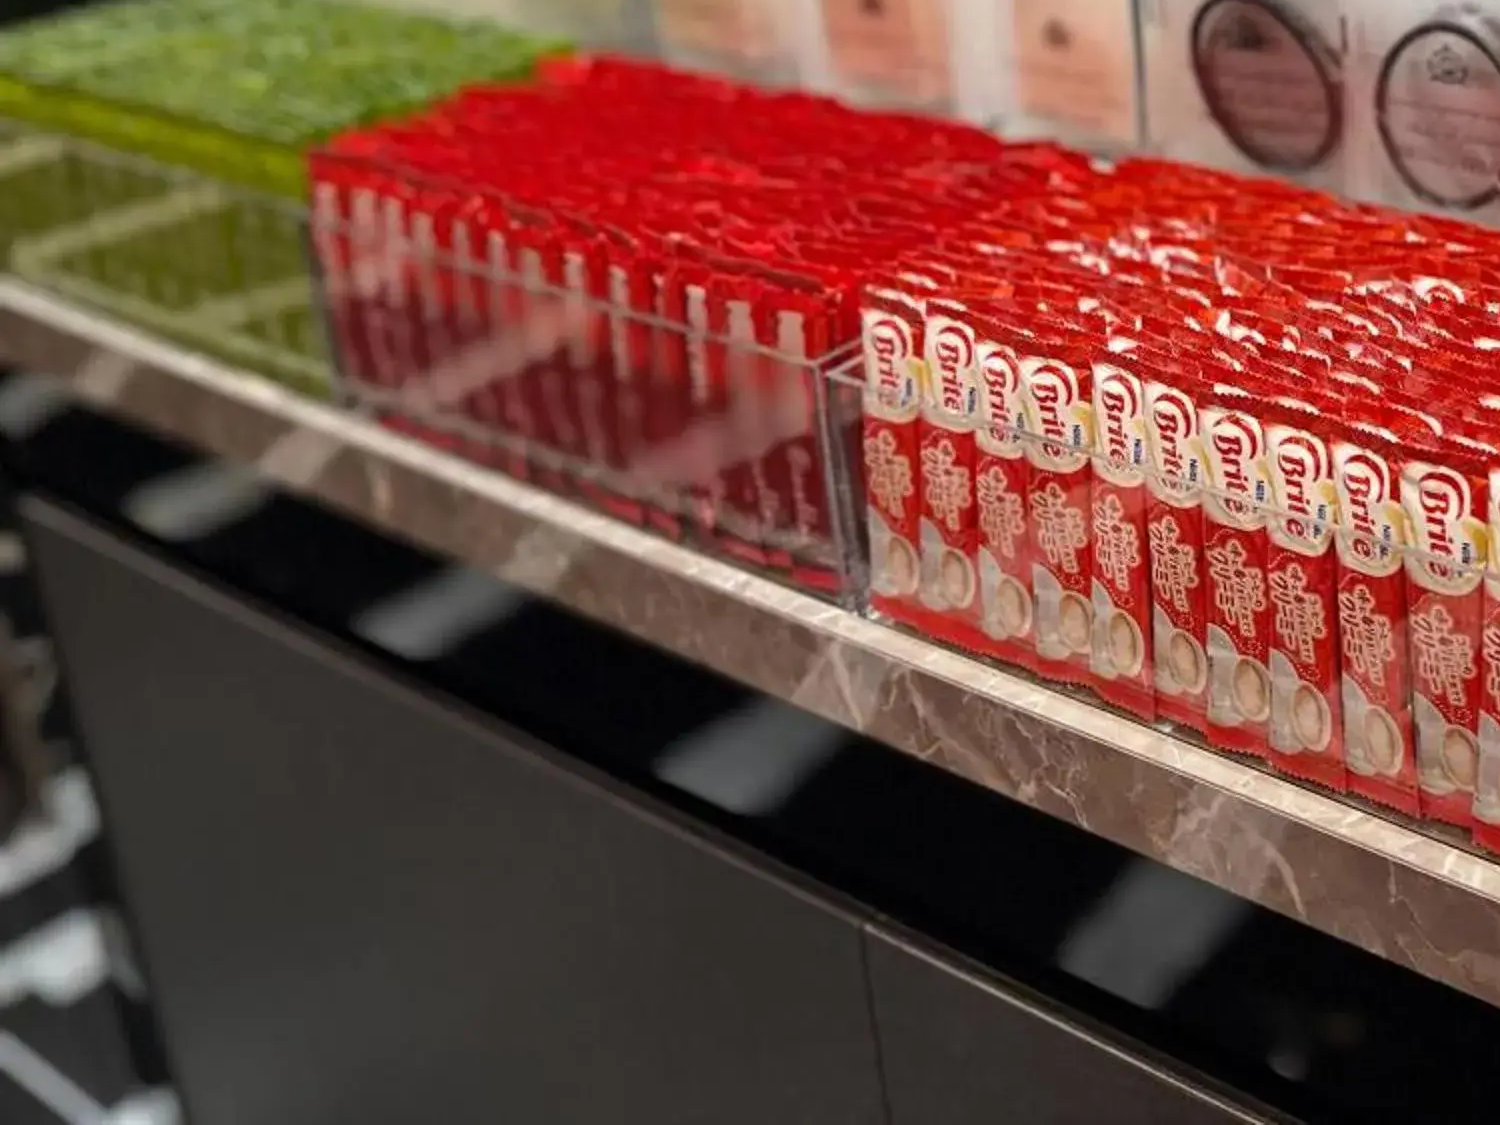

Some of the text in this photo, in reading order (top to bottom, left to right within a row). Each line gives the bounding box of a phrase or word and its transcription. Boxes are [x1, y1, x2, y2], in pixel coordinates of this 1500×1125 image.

[937, 344, 962, 411] Brite
[985, 368, 1009, 441] Brite
[1033, 383, 1066, 457] Brite
[1215, 435, 1252, 513] Brite
[1278, 455, 1310, 537] Brite
[1344, 475, 1375, 557] Brite
[1421, 490, 1455, 576] Brite
